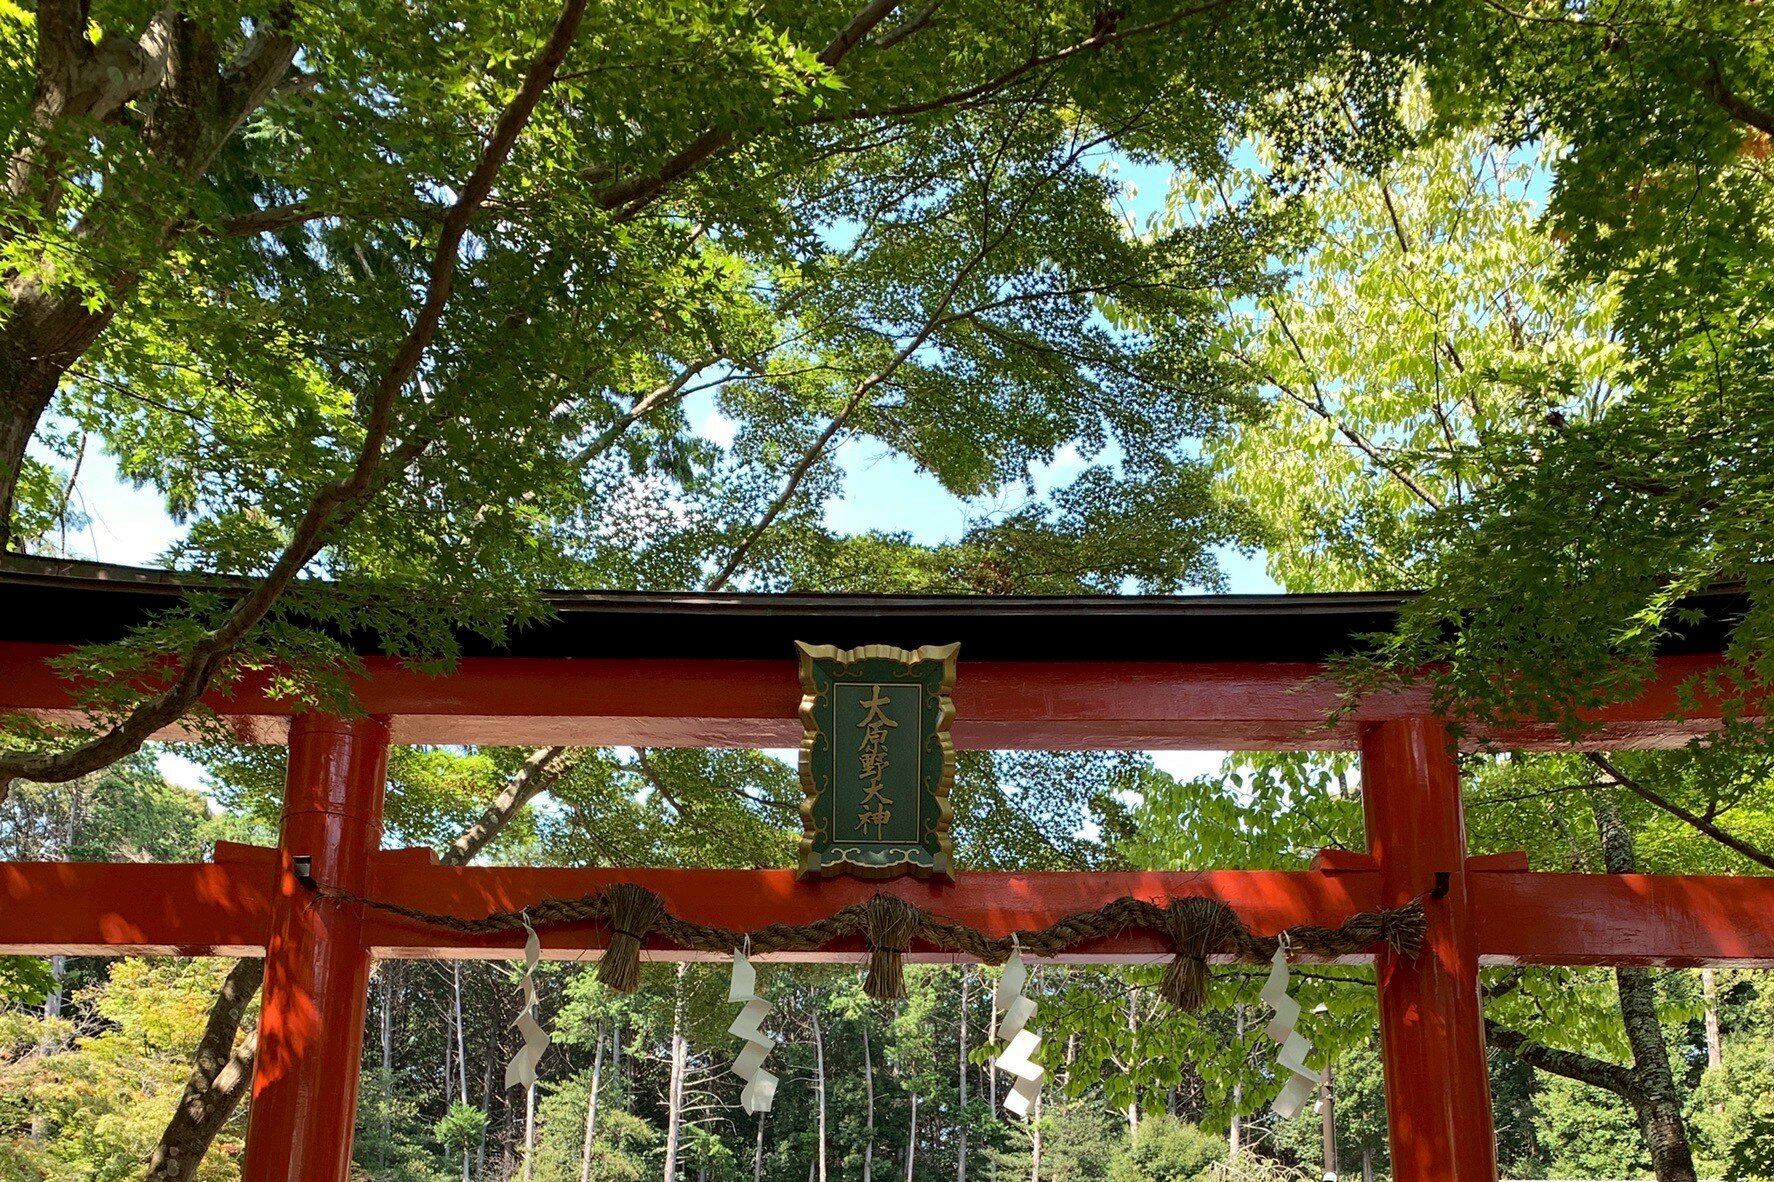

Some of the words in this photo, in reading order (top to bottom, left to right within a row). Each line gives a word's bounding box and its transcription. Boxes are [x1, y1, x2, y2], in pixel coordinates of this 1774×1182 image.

[855, 685, 898, 841] 大原野大神
